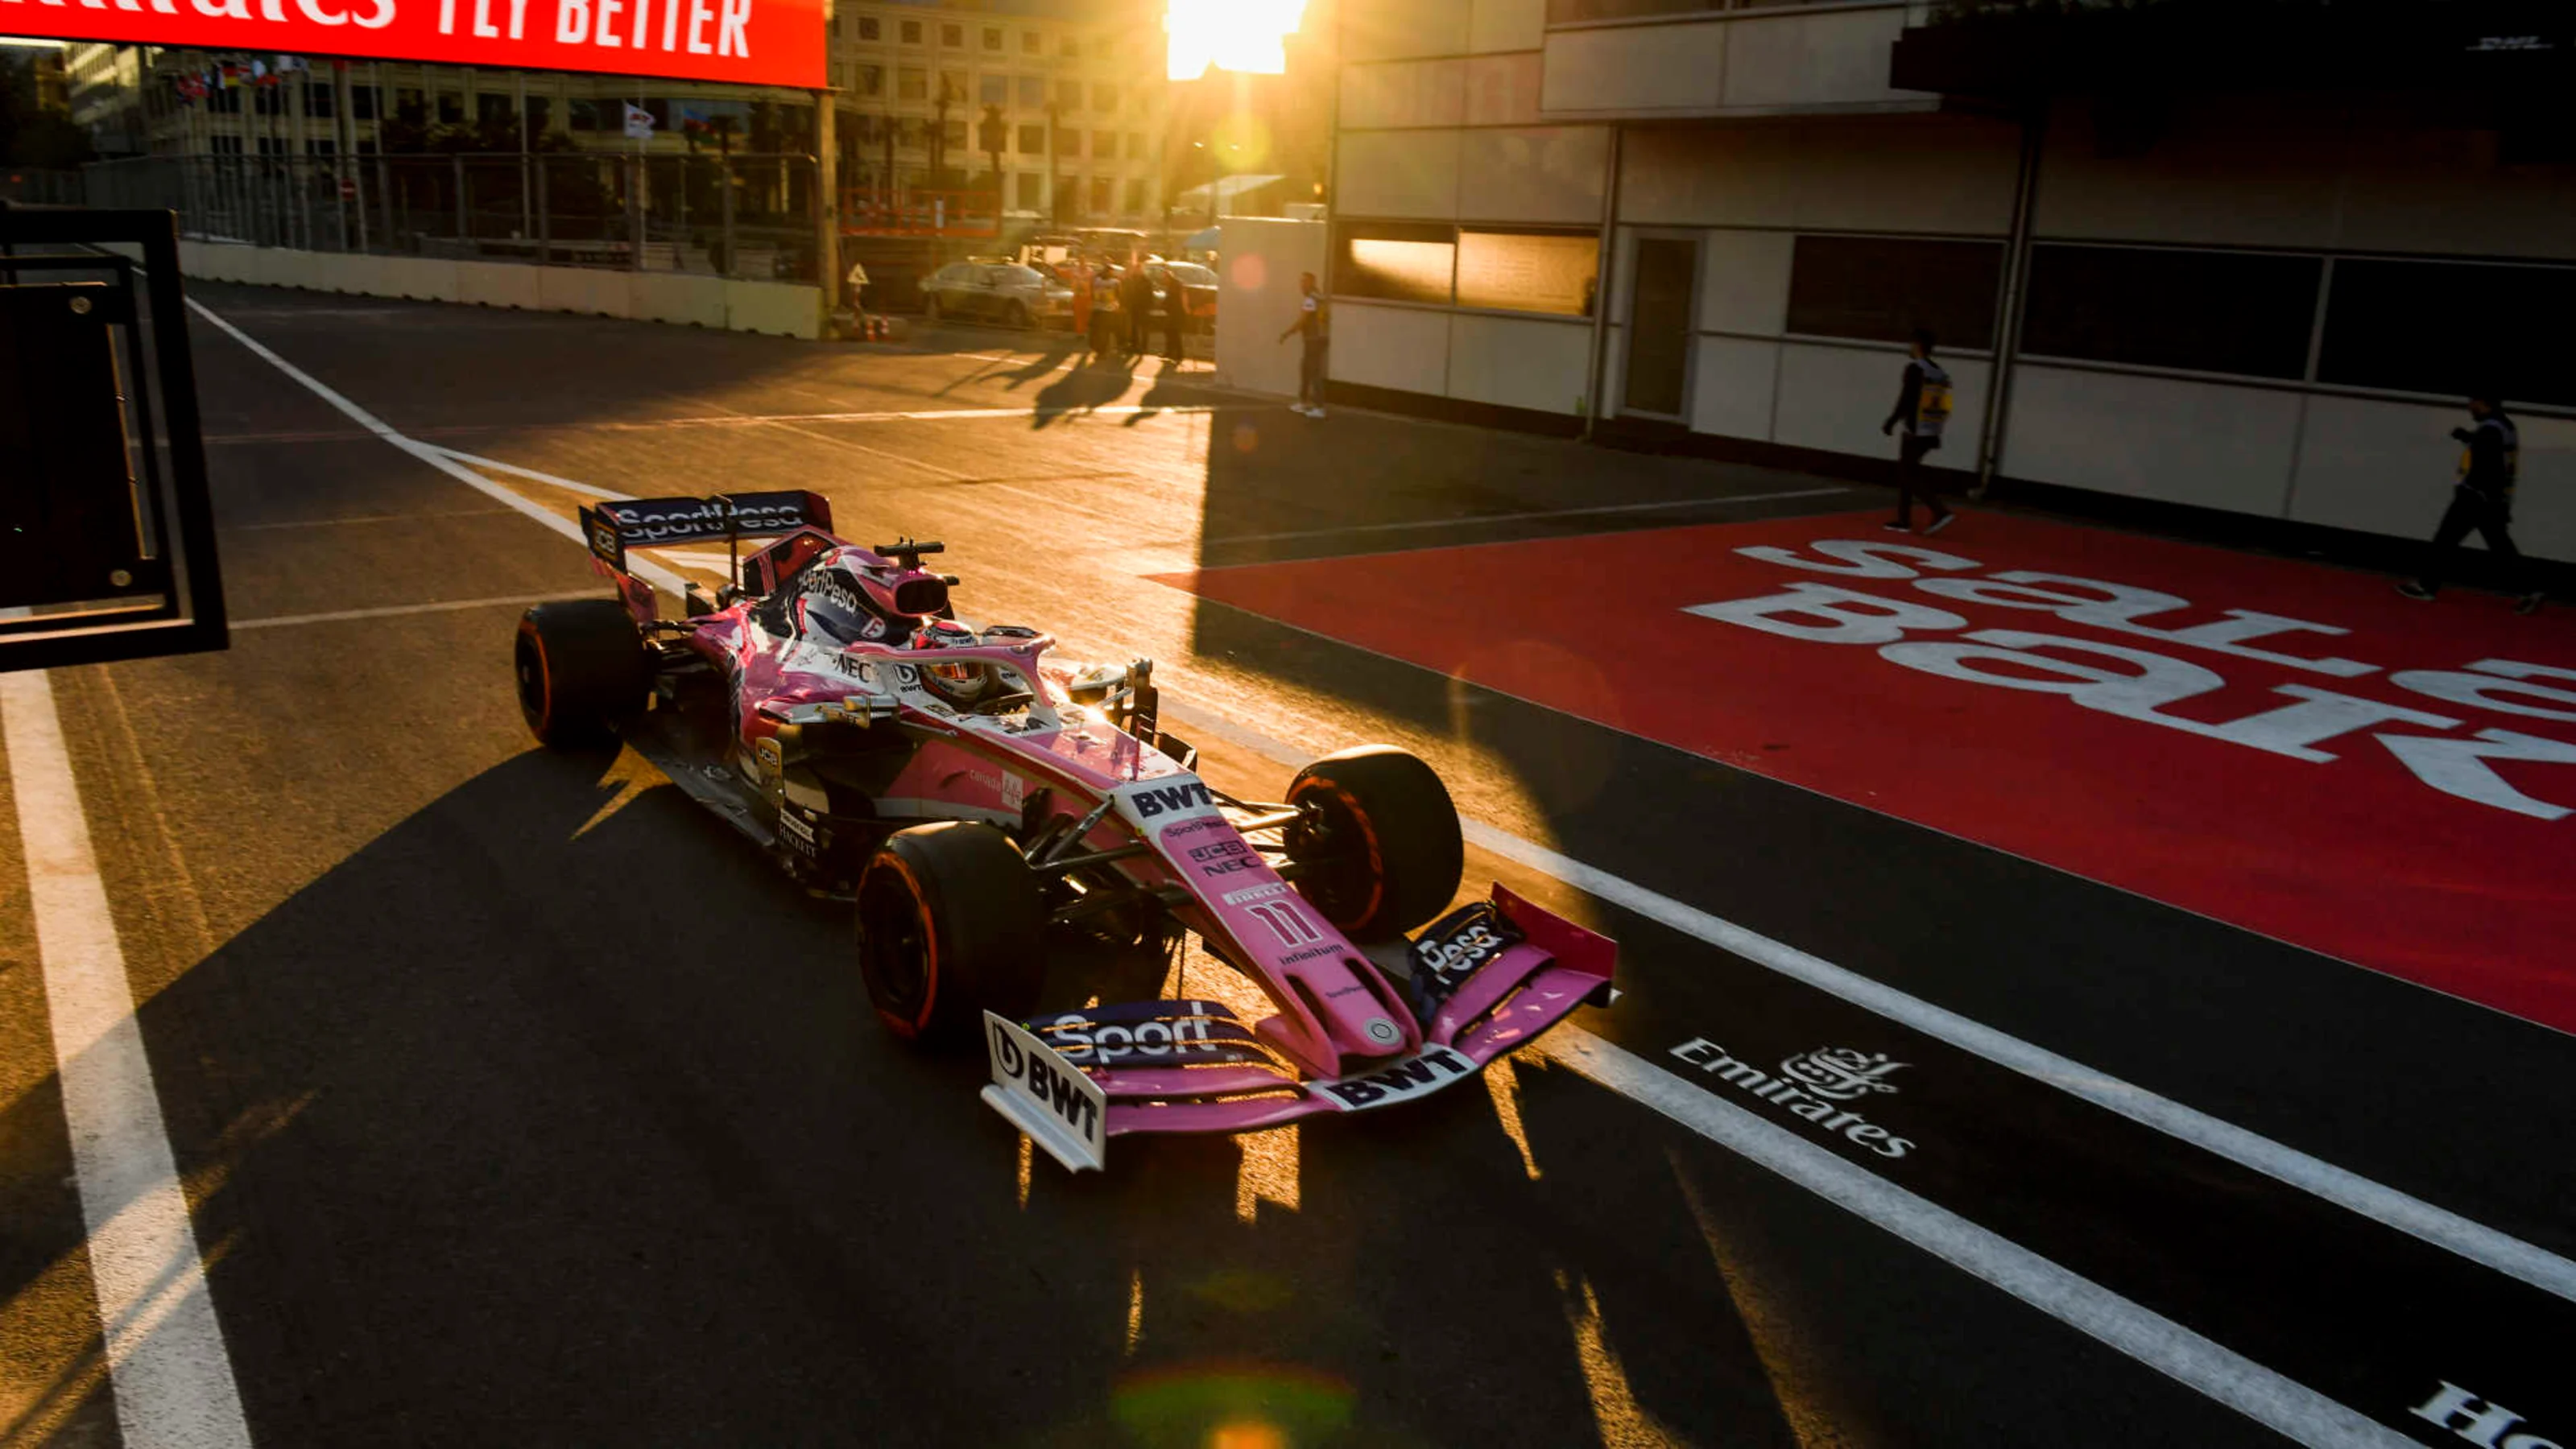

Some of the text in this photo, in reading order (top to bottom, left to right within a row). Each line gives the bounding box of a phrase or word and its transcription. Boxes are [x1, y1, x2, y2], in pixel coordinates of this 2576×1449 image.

[1131, 782, 1211, 818] BWT
[1203, 856, 1261, 877] NEC
[1244, 900, 1324, 949] 11
[1053, 1001, 1217, 1064] Sport
[1029, 1051, 1098, 1145] BWT
[1326, 1050, 1468, 1108] BWT
[1668, 1036, 1917, 1159] Emirates
